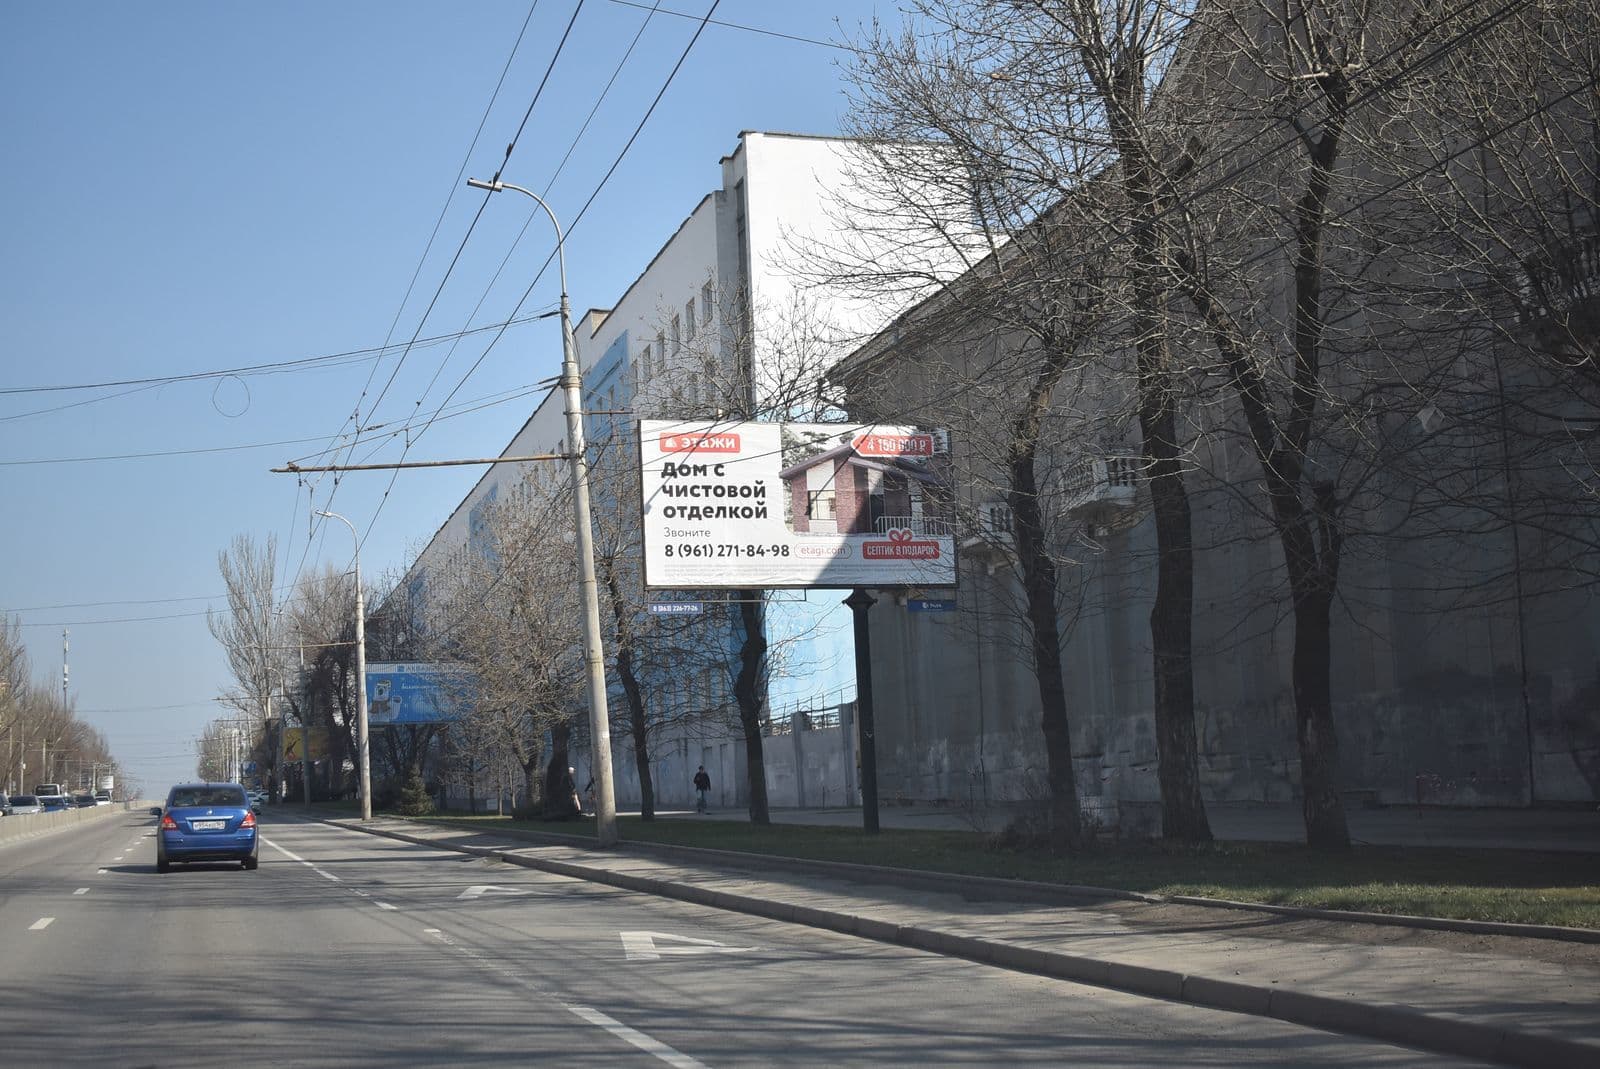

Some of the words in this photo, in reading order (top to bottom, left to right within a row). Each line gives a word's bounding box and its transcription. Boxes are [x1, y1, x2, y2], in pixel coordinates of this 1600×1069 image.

[681, 437, 736, 449] этажи
[867, 438, 874, 451] 4
[878, 438, 896, 452] 150
[661, 462, 708, 479] Дом
[713, 463, 725, 477] с
[661, 480, 766, 498] чистовой
[662, 501, 768, 521] отделкой
[663, 527, 711, 538] Звоните
[664, 544, 674, 557] 8
[678, 543, 713, 558] (961)
[717, 544, 790, 557] 271-84-98
[800, 544, 846, 557] etagi.com
[867, 545, 894, 556] СЕПТИК
[896, 545, 901, 556] В
[902, 545, 935, 556] ПОДАРОК
